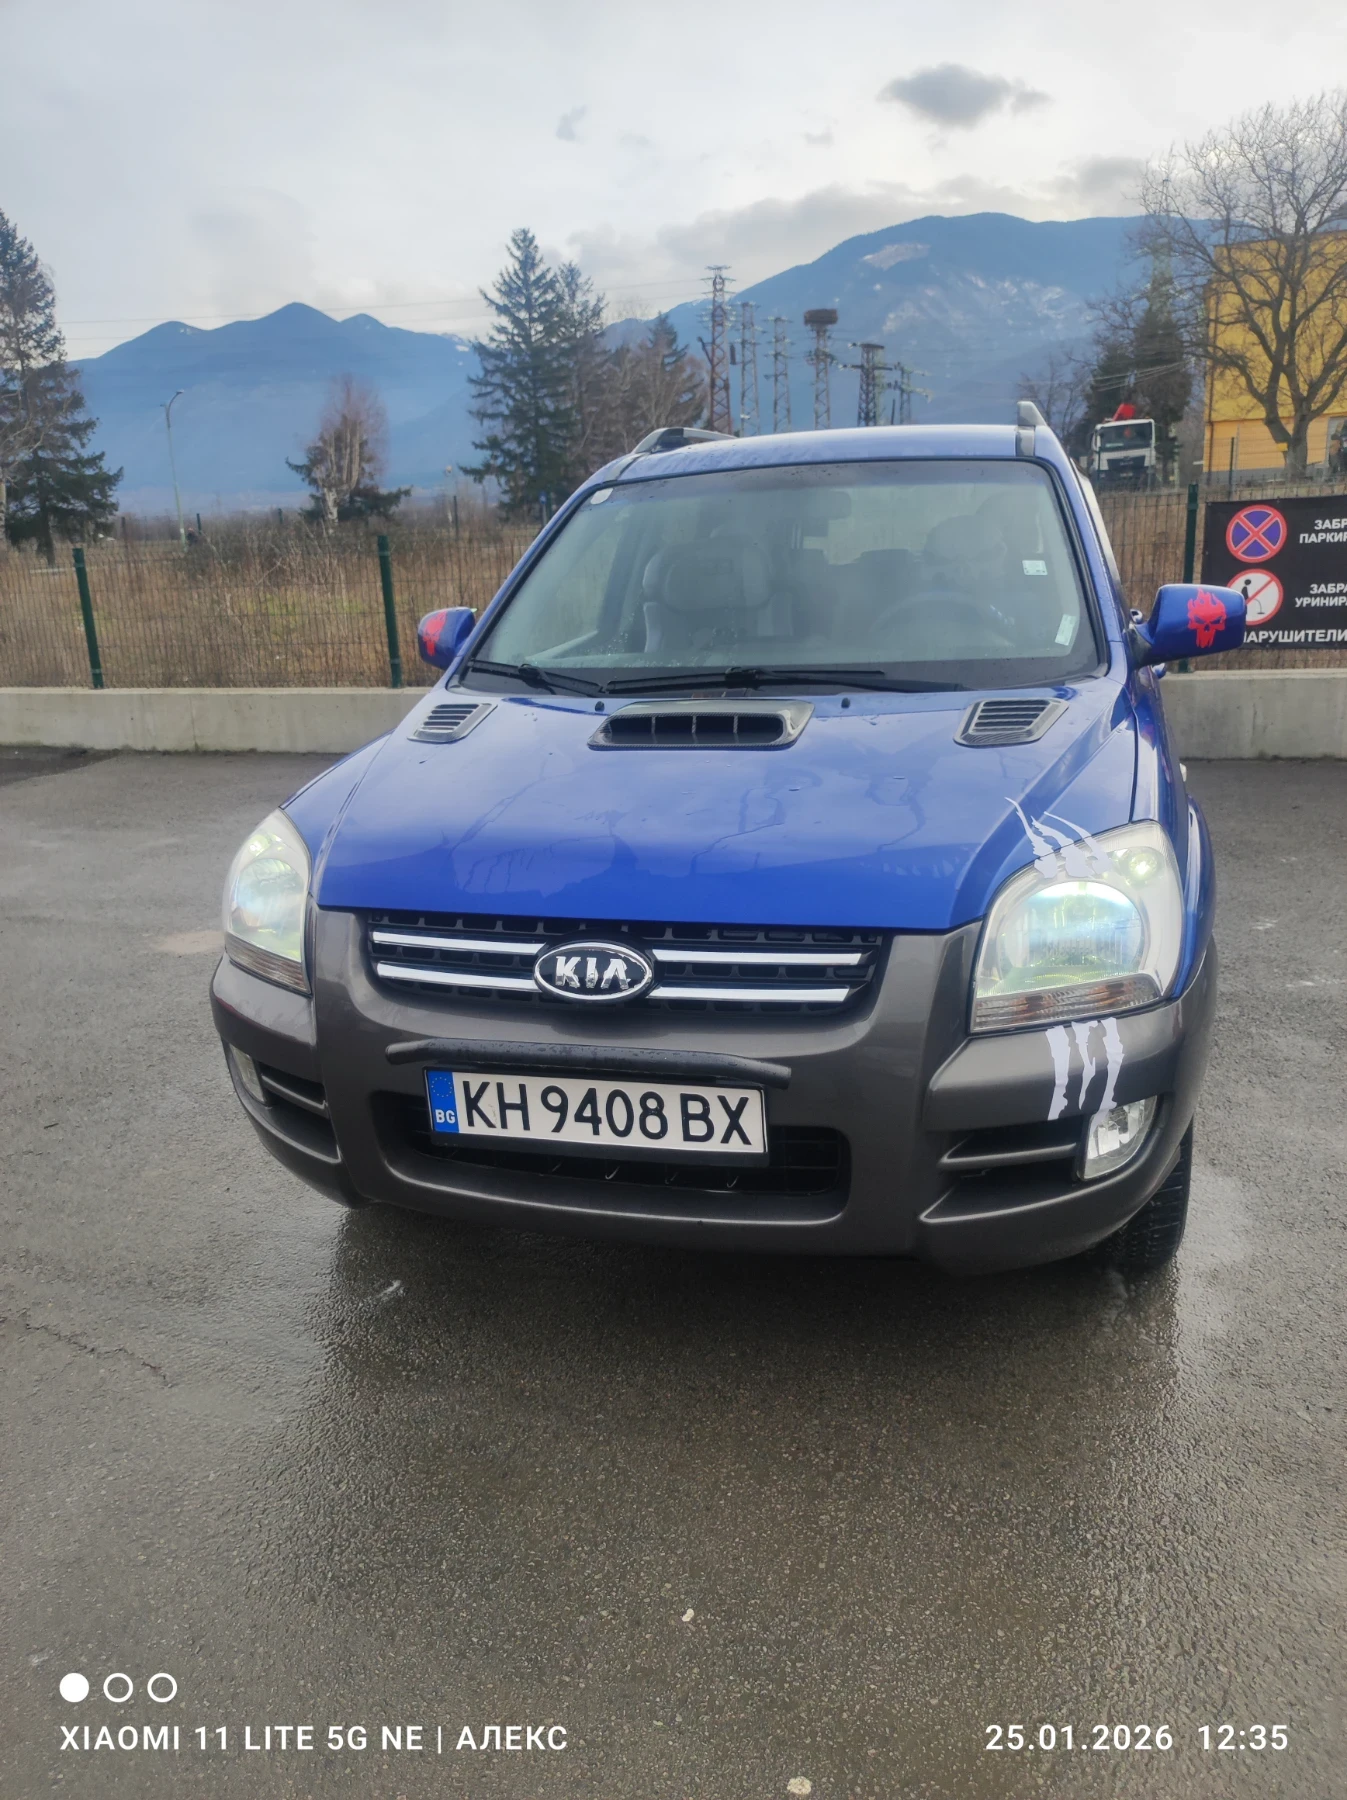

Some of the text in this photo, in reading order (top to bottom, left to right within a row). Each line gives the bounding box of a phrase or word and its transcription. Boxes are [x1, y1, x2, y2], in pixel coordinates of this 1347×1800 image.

[1295, 595, 1347, 608] УРИНИР
[554, 955, 629, 990] KIA
[435, 1108, 456, 1124] BG
